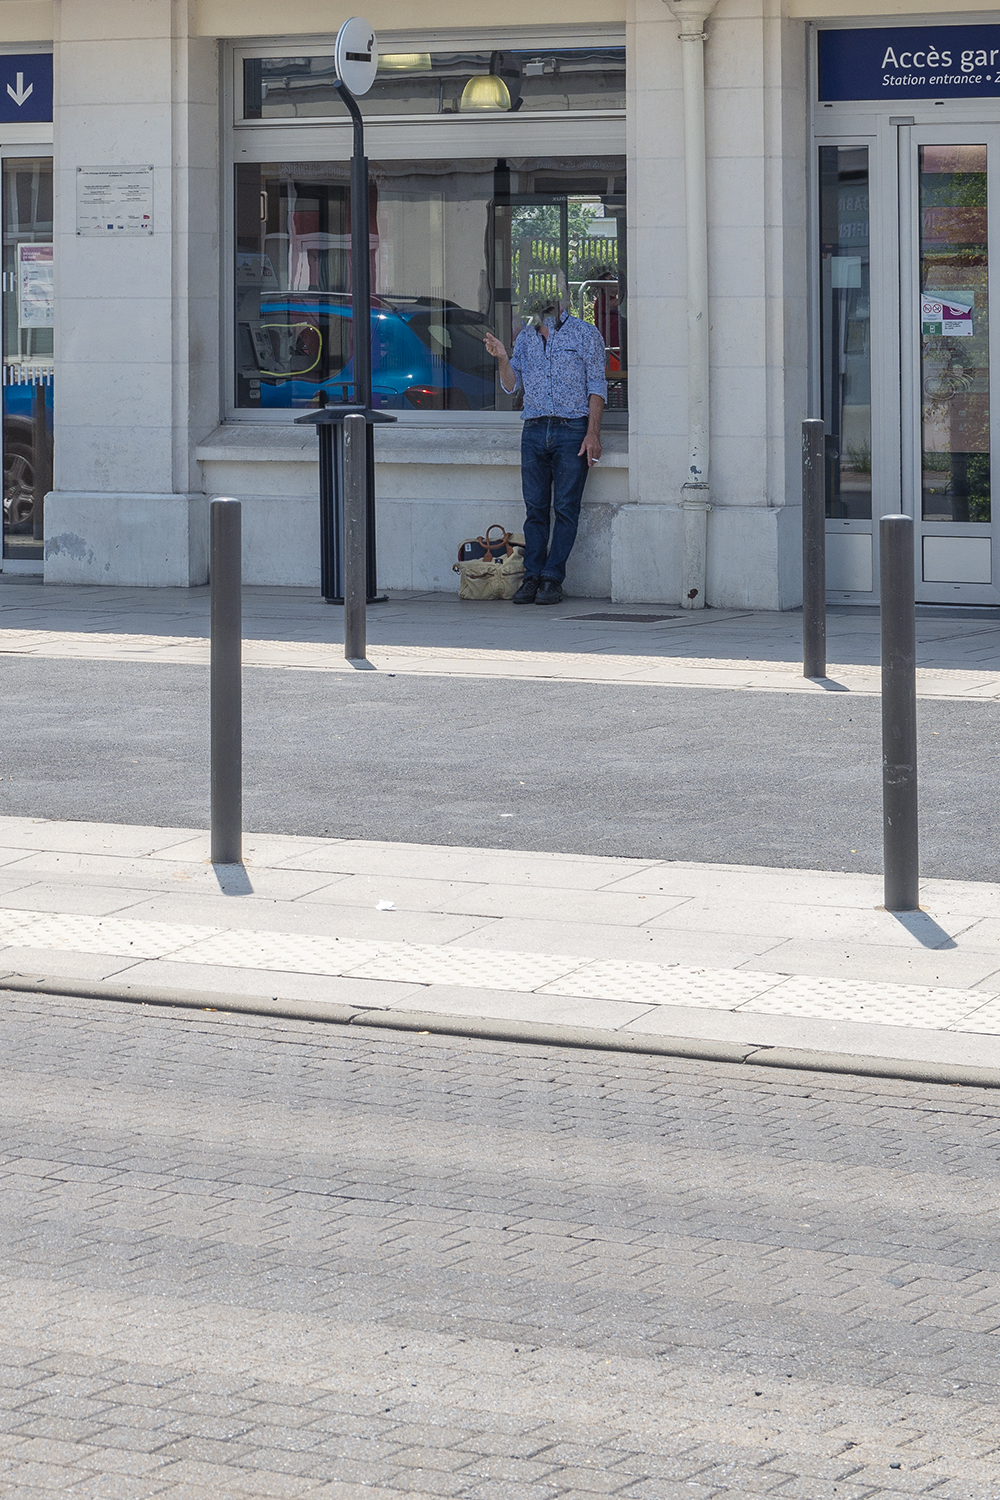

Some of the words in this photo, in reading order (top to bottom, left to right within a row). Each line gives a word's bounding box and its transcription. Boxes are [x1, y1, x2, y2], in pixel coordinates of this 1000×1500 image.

[881, 45, 953, 69] Accès
[882, 74, 926, 86] Station
[929, 73, 982, 84] entrance
